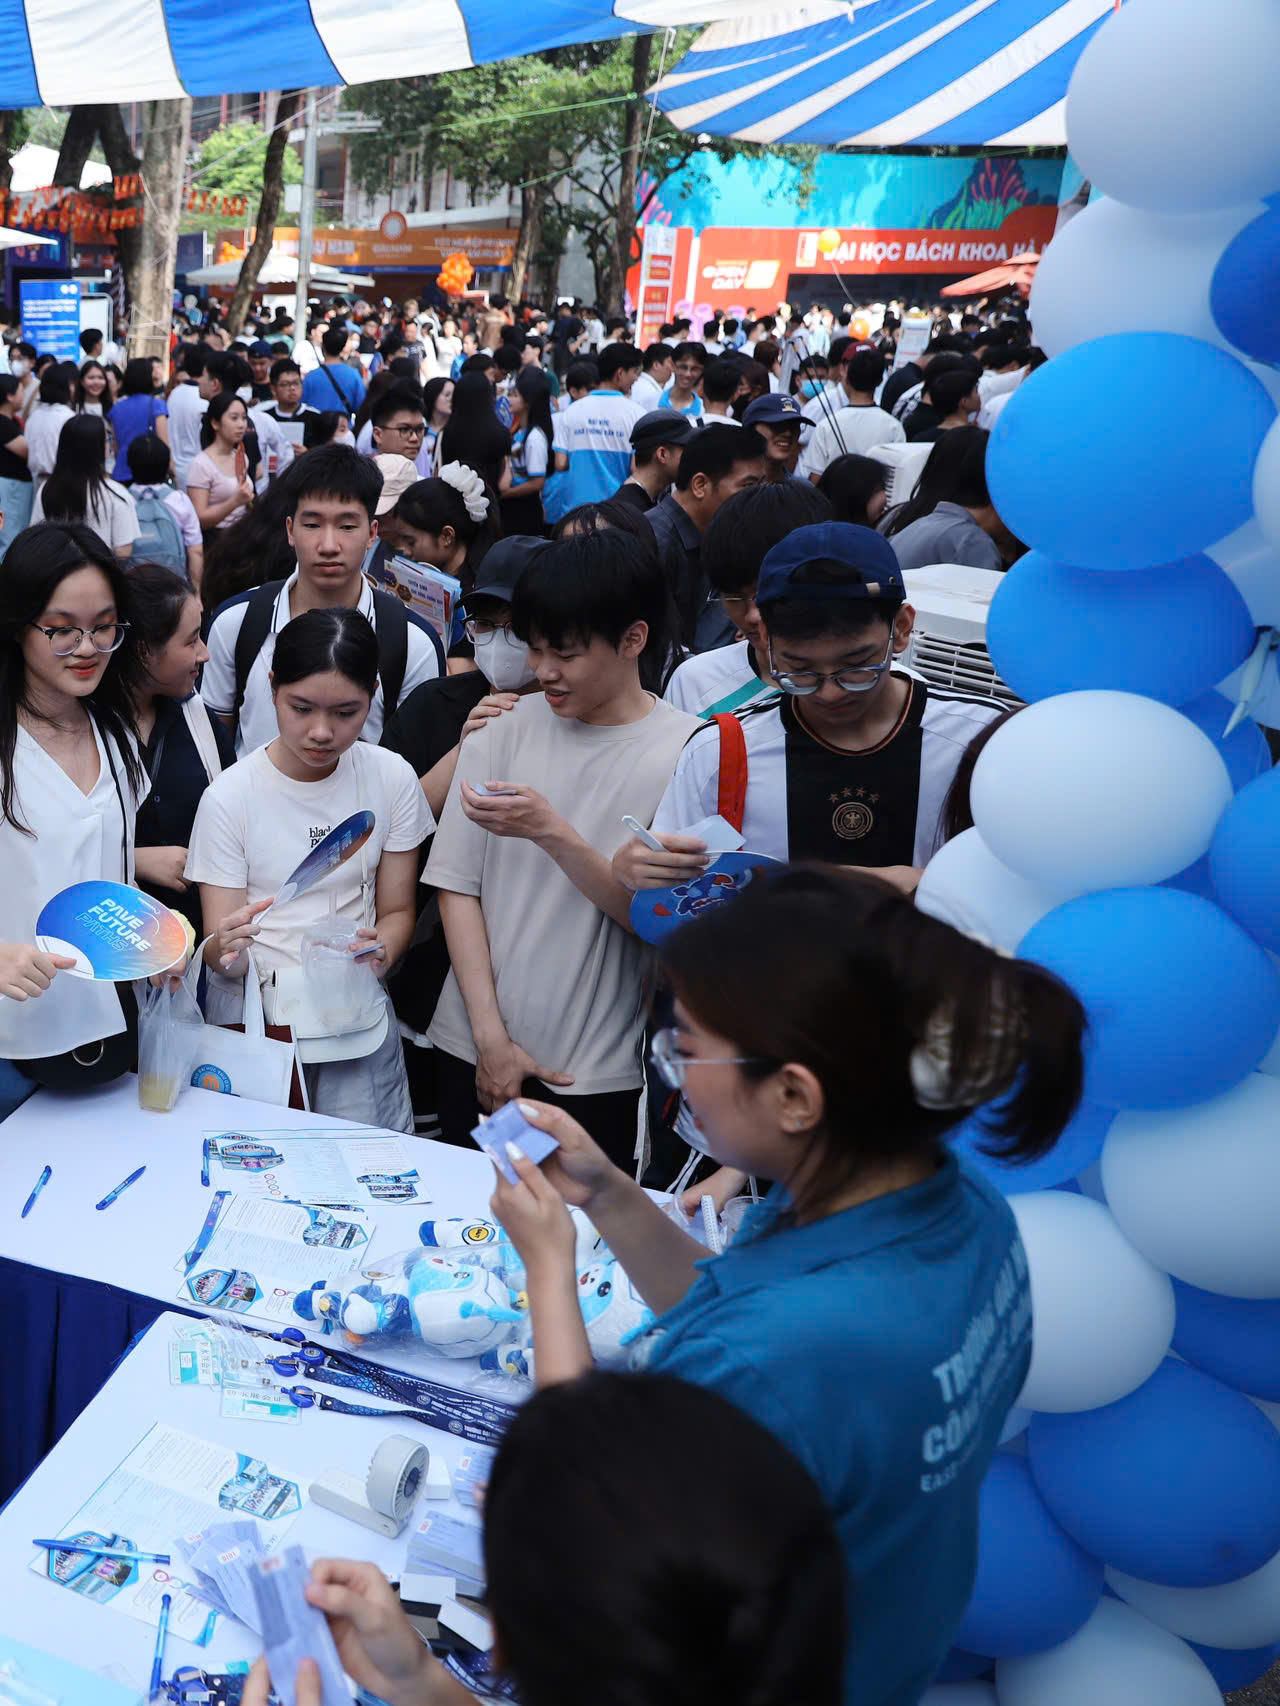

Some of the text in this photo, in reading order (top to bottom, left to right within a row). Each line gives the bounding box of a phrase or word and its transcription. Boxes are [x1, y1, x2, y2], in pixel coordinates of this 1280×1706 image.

[859, 241, 903, 263] HỌC
[904, 238, 957, 261] BÁCH
[958, 241, 1009, 261] KHOA
[75, 912, 132, 951] PATHS
[88, 905, 152, 952] FUTURE
[100, 897, 144, 930] PAVE
